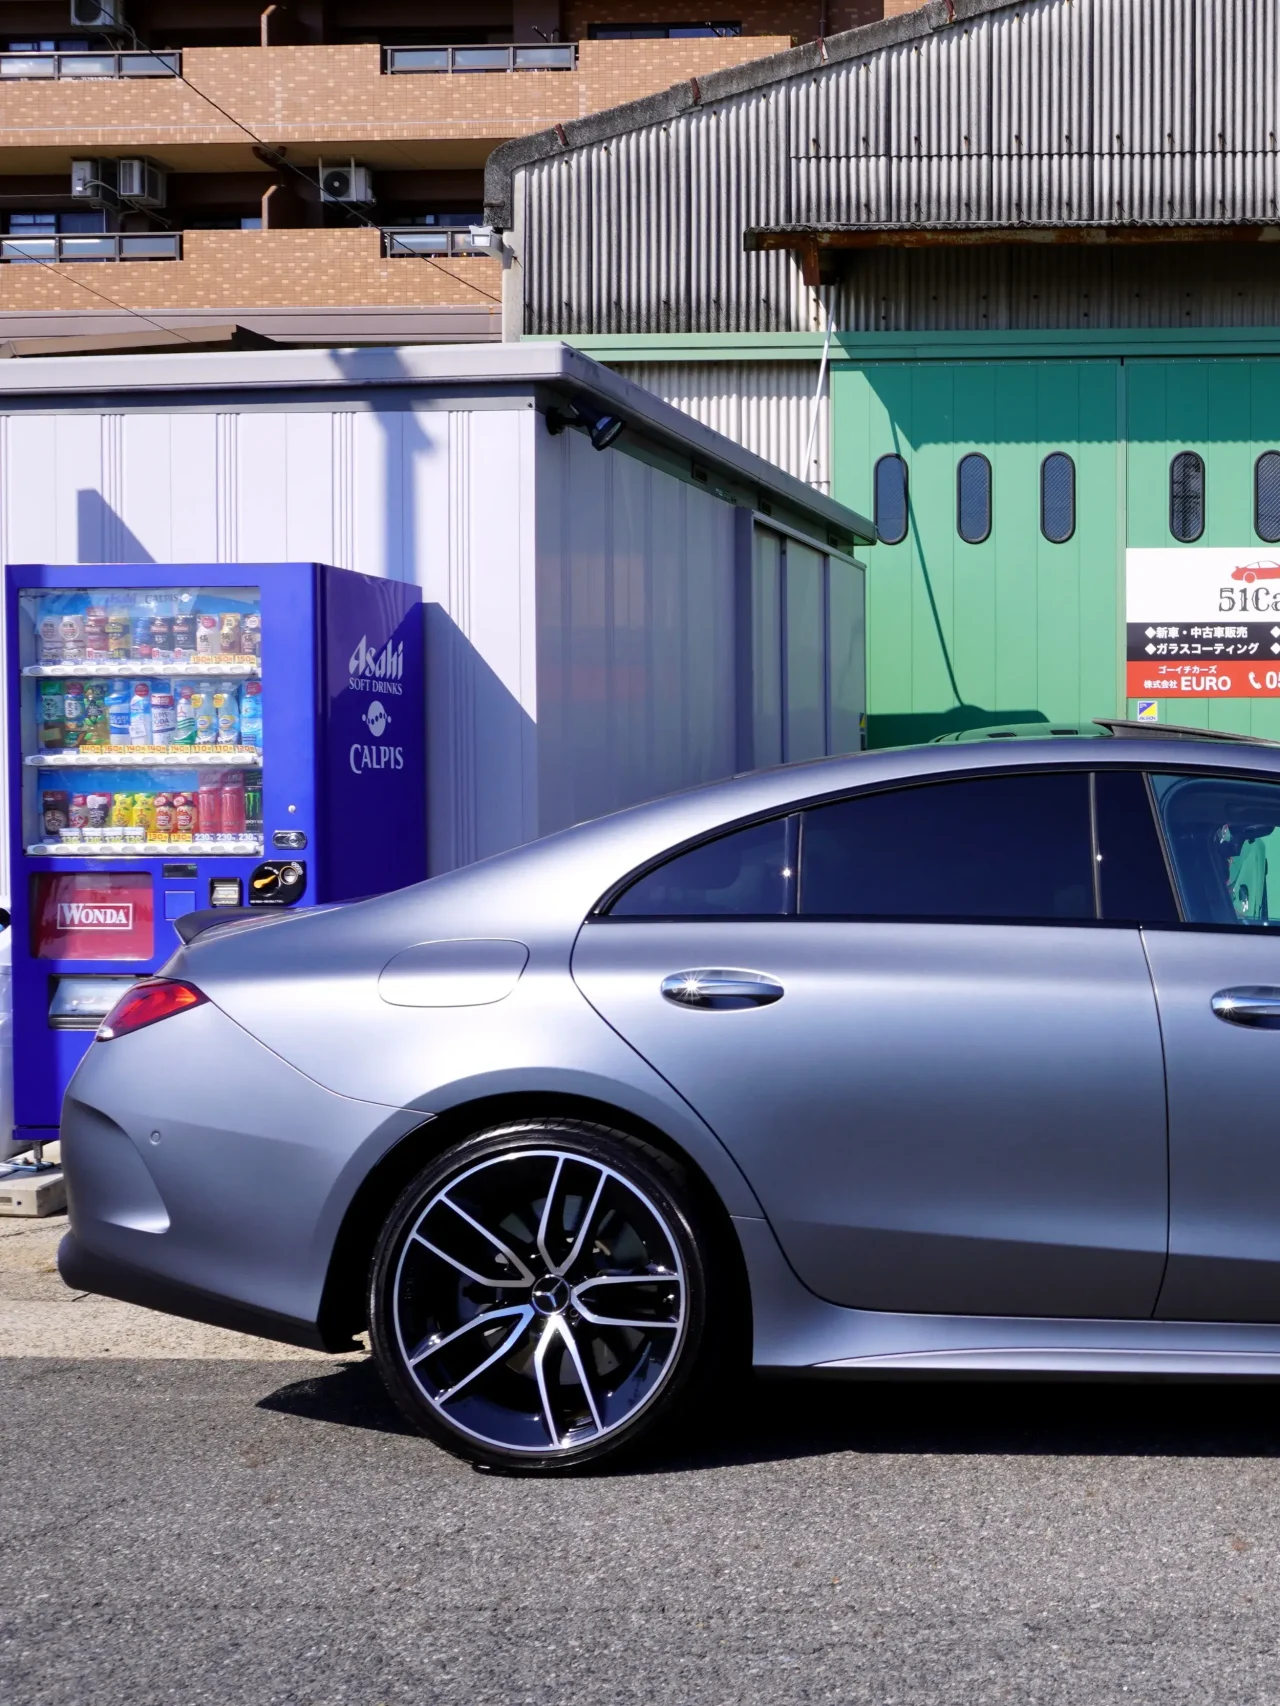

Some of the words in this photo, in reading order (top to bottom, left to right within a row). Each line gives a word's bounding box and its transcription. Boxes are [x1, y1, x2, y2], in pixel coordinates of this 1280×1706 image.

[348, 634, 404, 681] Asahi
[1156, 642, 1260, 655] ガラスコーティング
[1158, 665, 1218, 675] ゴーイチカーズ
[349, 677, 371, 692] SOFT
[372, 680, 403, 695] DRINKS
[1143, 679, 1178, 689] 株式会社
[1180, 676, 1232, 691] EURO
[350, 743, 404, 775] CALPIS
[61, 903, 128, 925] WONDA
